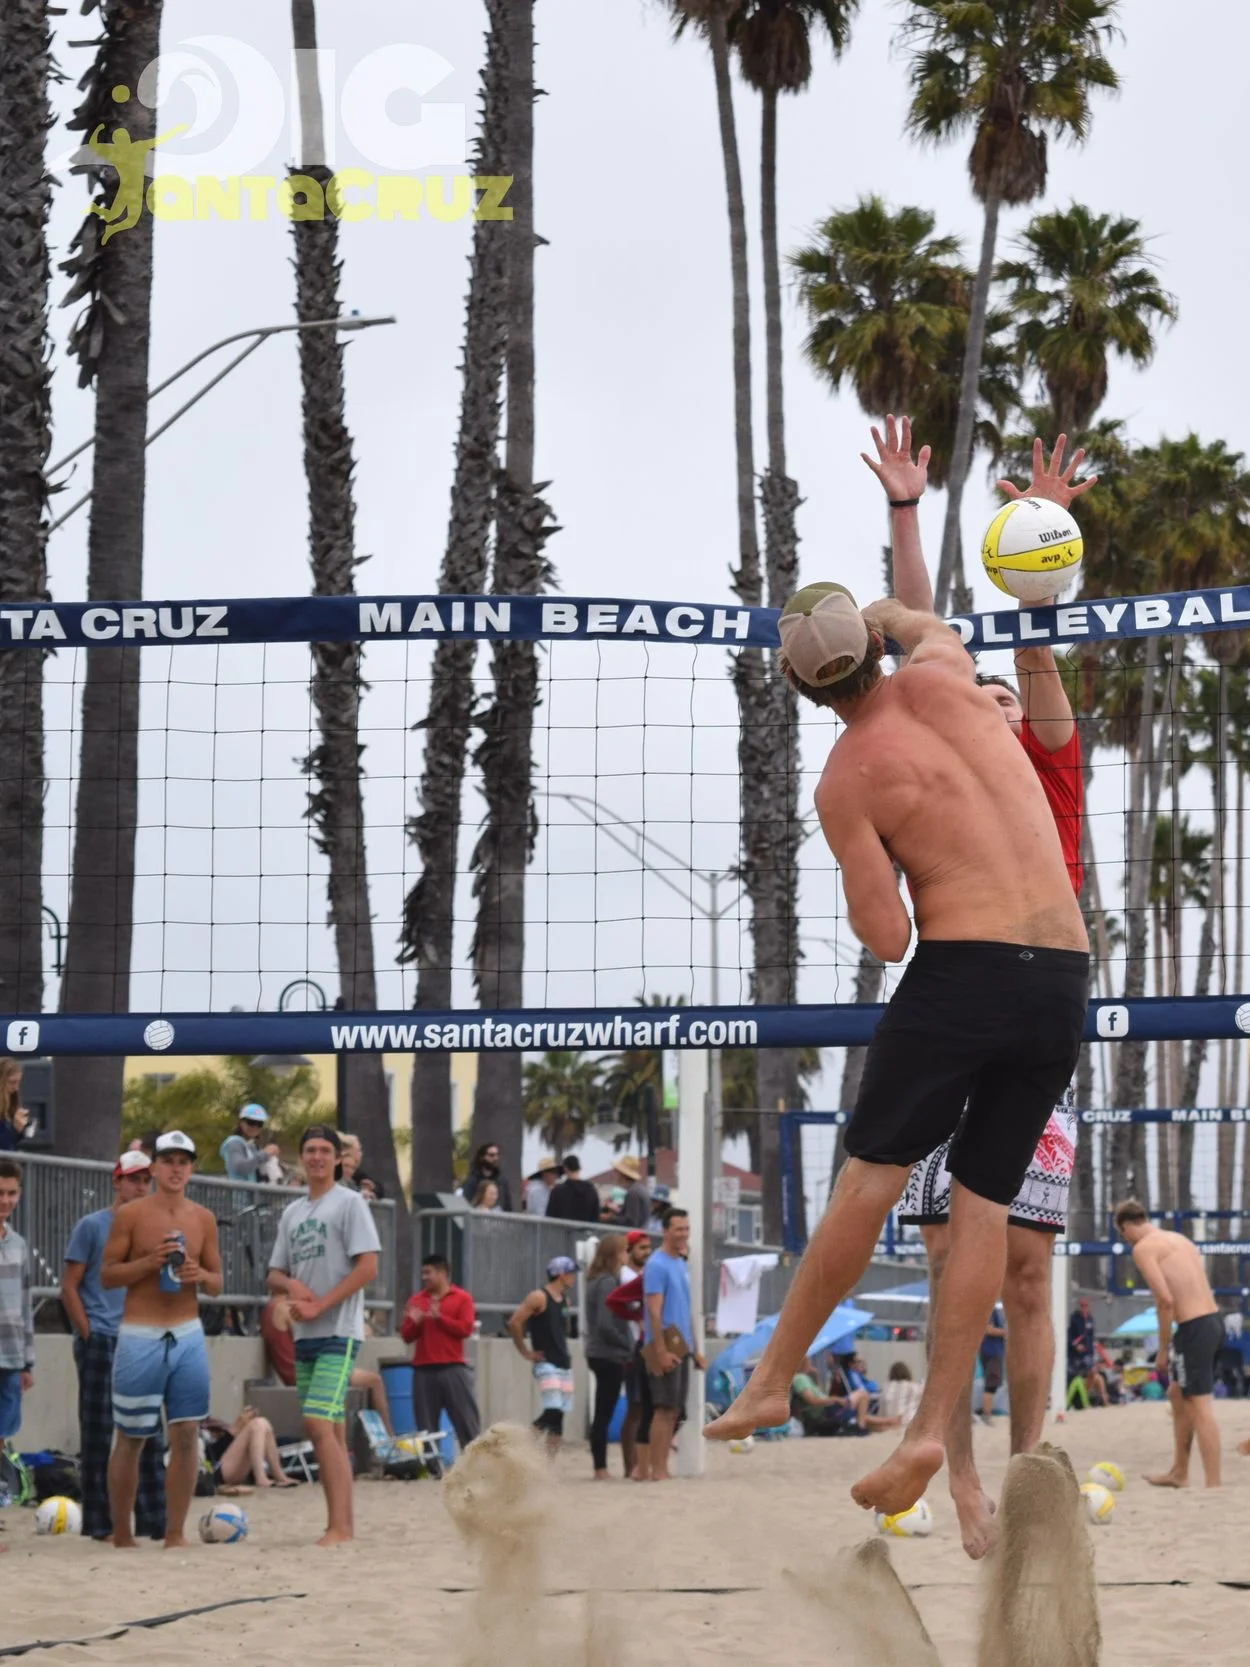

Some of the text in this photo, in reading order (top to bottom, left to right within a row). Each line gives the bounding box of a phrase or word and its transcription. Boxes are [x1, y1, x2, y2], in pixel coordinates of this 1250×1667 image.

[1038, 528, 1072, 543] Wilson
[1041, 553, 1061, 565] avp
[80, 606, 229, 640] CRUZ
[359, 602, 750, 640] MAIN BEACH
[331, 1014, 757, 1050] www.santacruzwharf.com
[1082, 1111, 1131, 1123] CRUZ
[1172, 1109, 1222, 1121] MAIN
